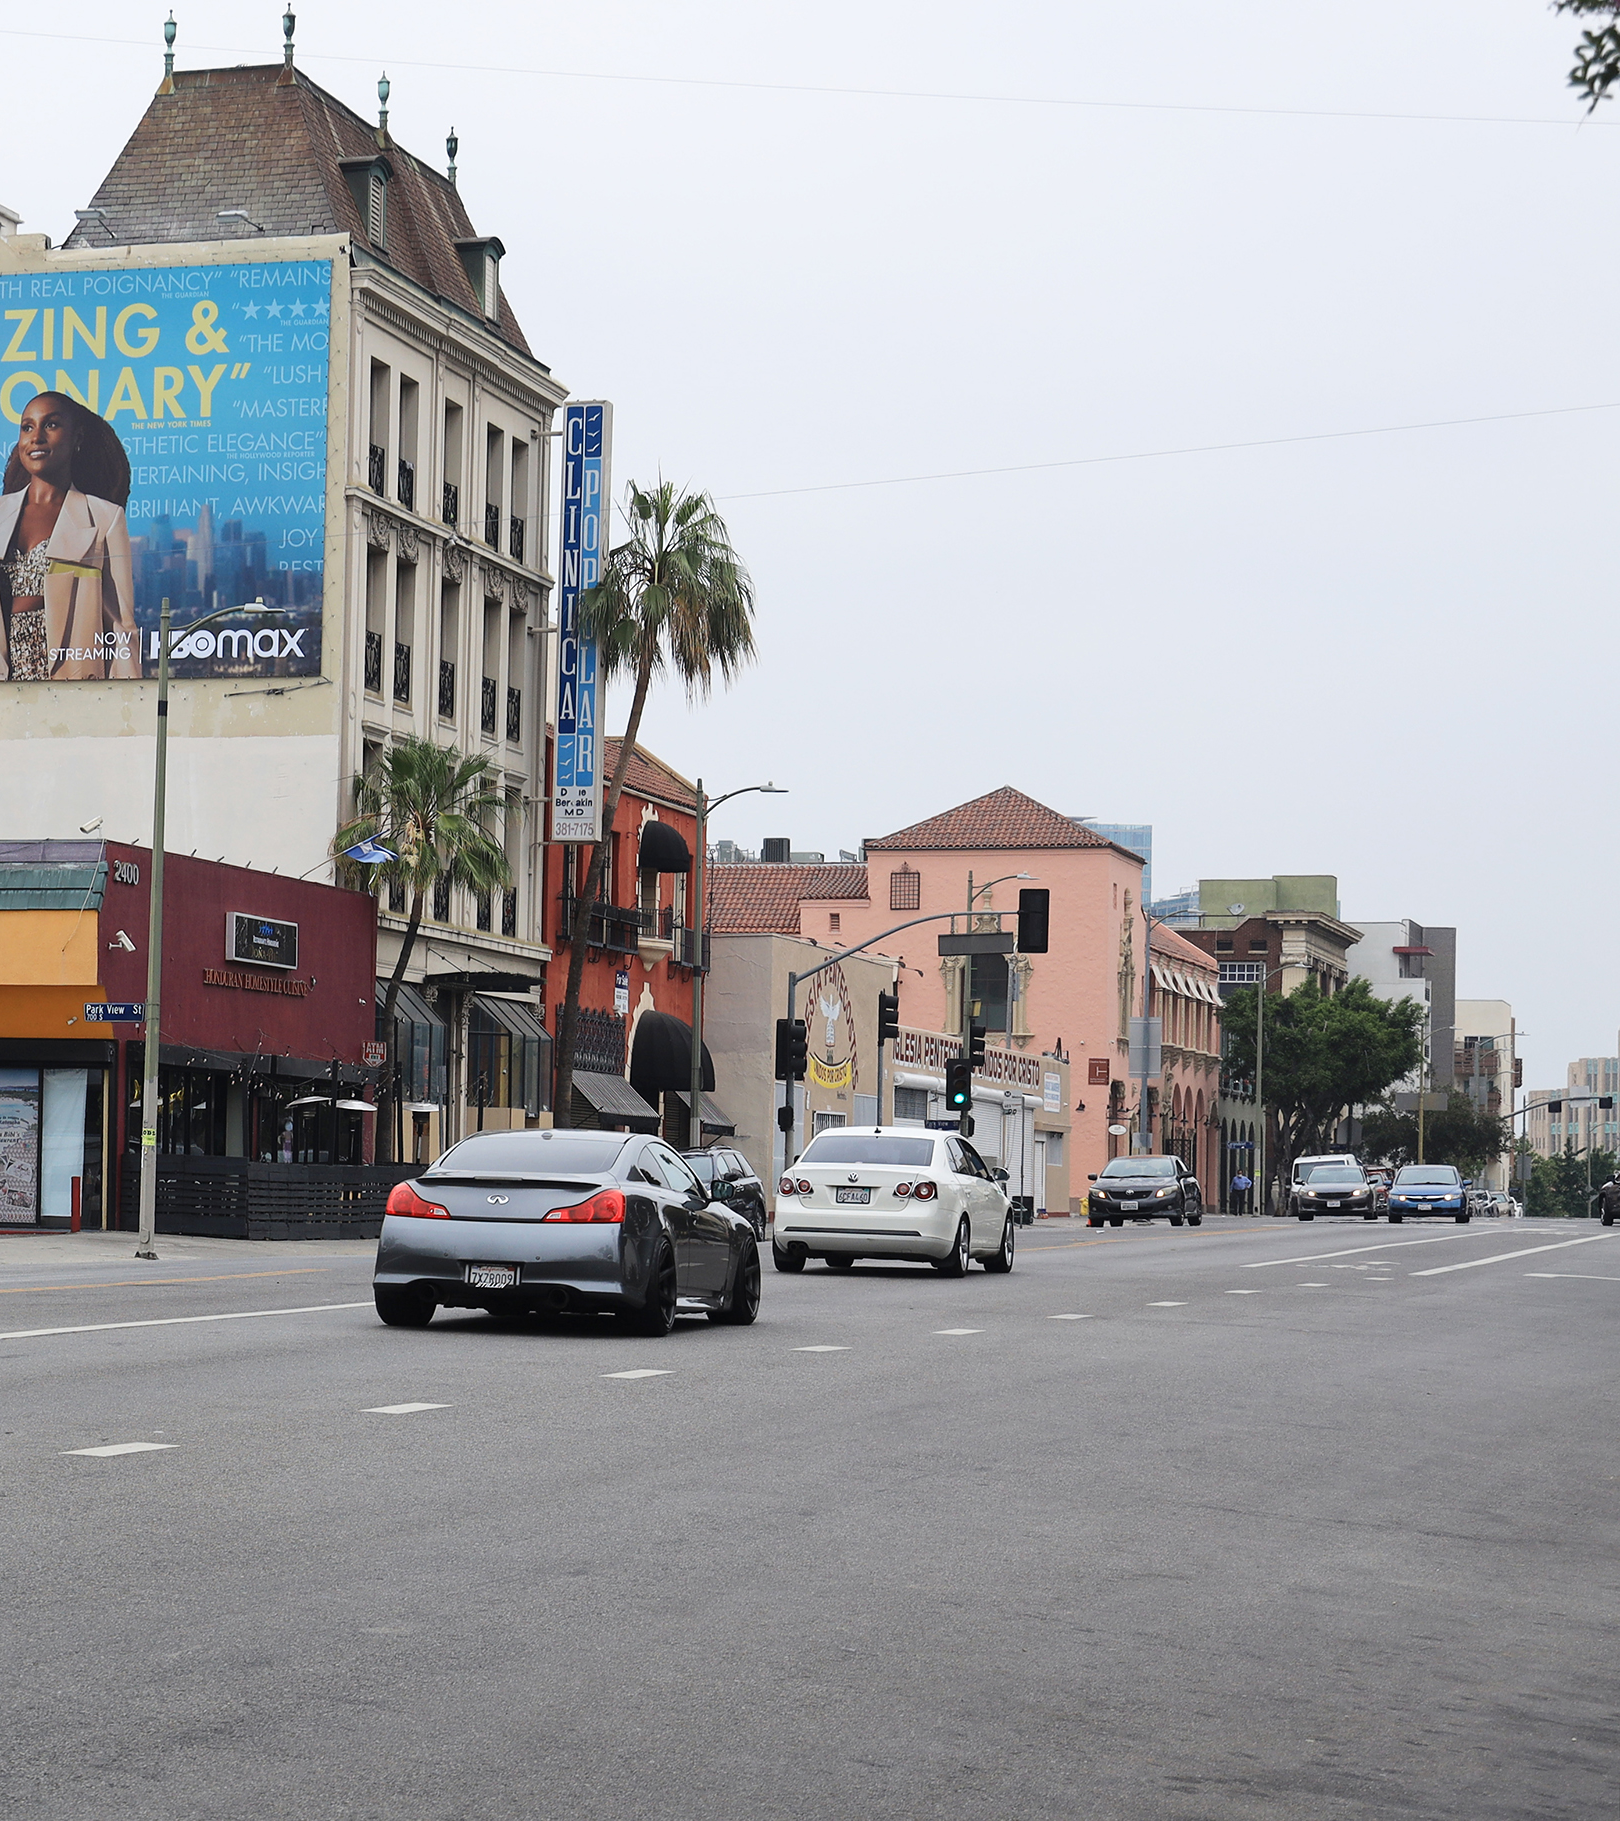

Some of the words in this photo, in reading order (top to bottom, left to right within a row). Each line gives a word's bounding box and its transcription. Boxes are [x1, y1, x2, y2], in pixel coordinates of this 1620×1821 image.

[31, 279, 75, 298] REAL
[175, 291, 209, 299] GUARDIAN
[185, 300, 230, 355] &
[294, 318, 328, 326] GUARDIAN
[131, 422, 145, 430] THE
[147, 421, 165, 429] NEW
[240, 451, 281, 459] HOLLYWOOD
[279, 528, 318, 549] JOY
[559, 417, 583, 720] CLINICA
[577, 469, 599, 772] POPLAR
[94, 631, 131, 645] NOW
[49, 647, 131, 661] STREAMING
[555, 822, 594, 836] 381-7175
[114, 860, 140, 886] 2400
[244, 973, 283, 994] HOMESTYLE
[86, 1004, 104, 1015] Park
[107, 1004, 125, 1015] View
[132, 1004, 142, 1015] St
[86, 1013, 97, 1021] 700
[366, 1042, 384, 1054] ATM
